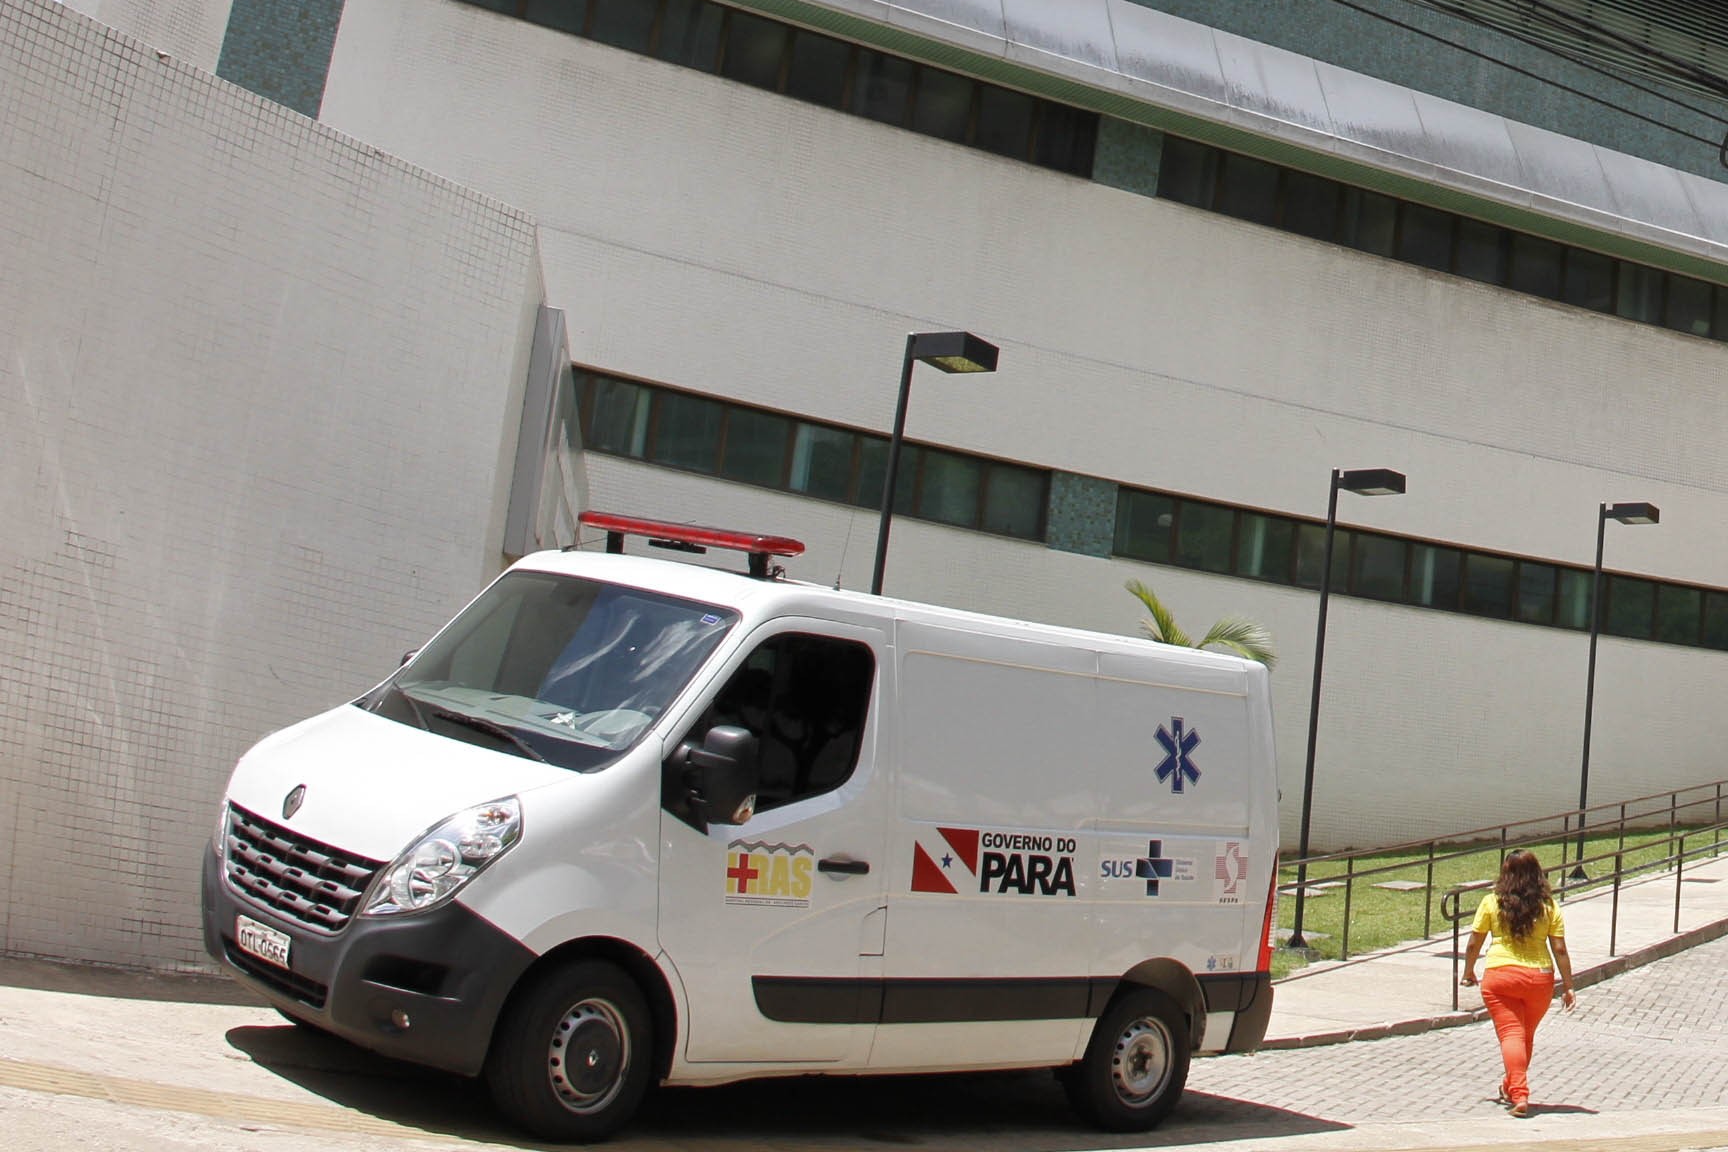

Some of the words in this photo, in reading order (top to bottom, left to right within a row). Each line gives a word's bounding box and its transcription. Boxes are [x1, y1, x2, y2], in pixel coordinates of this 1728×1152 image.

[982, 832, 1052, 852] GOVERNO
[1056, 838, 1076, 853] DO
[980, 851, 1076, 896] PARÁ
[1100, 860, 1133, 878] SUS
